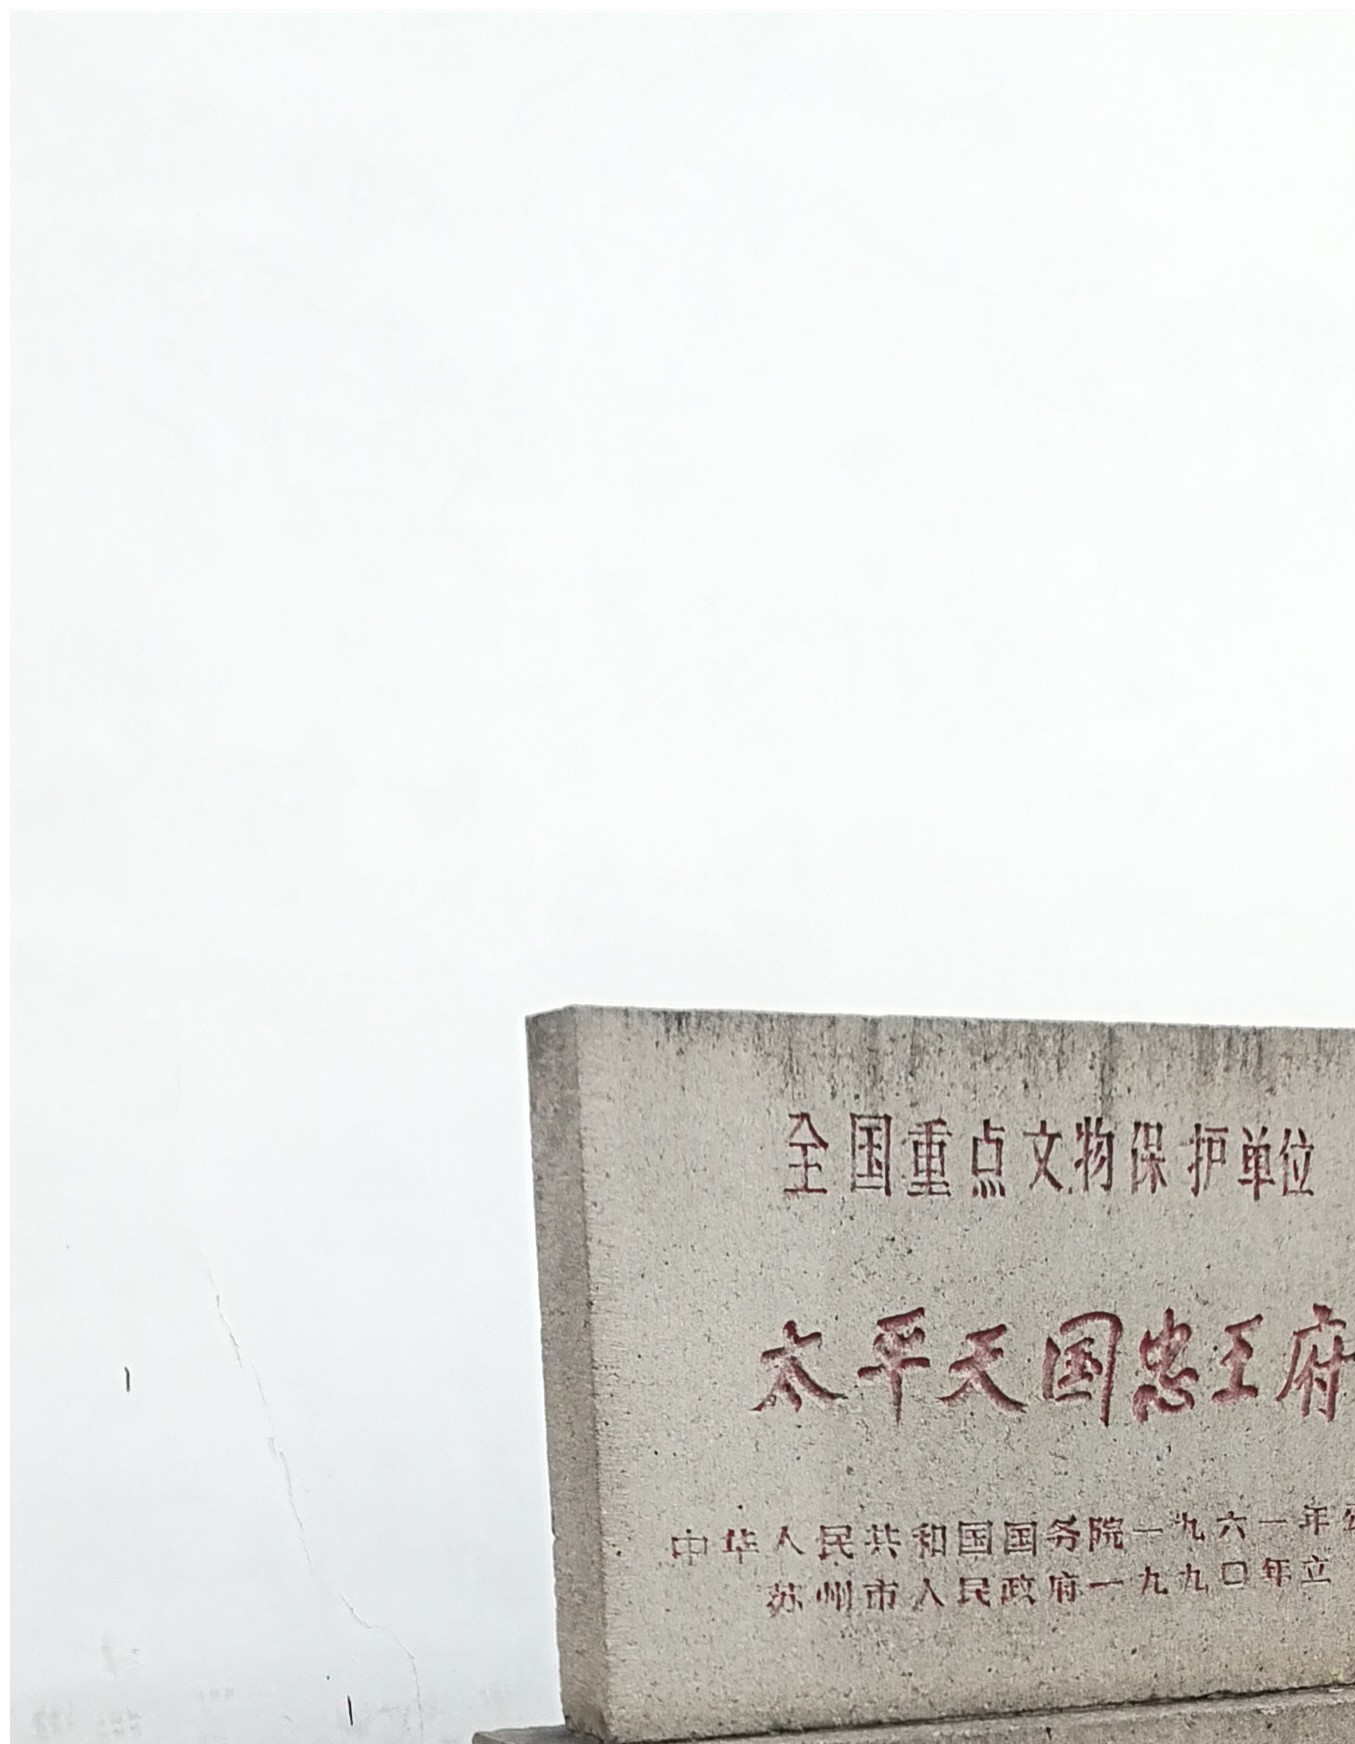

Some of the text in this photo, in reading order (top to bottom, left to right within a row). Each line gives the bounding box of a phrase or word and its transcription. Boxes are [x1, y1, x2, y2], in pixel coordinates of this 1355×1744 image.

[783, 1111, 1316, 1200] 全国重点文物保护单位
